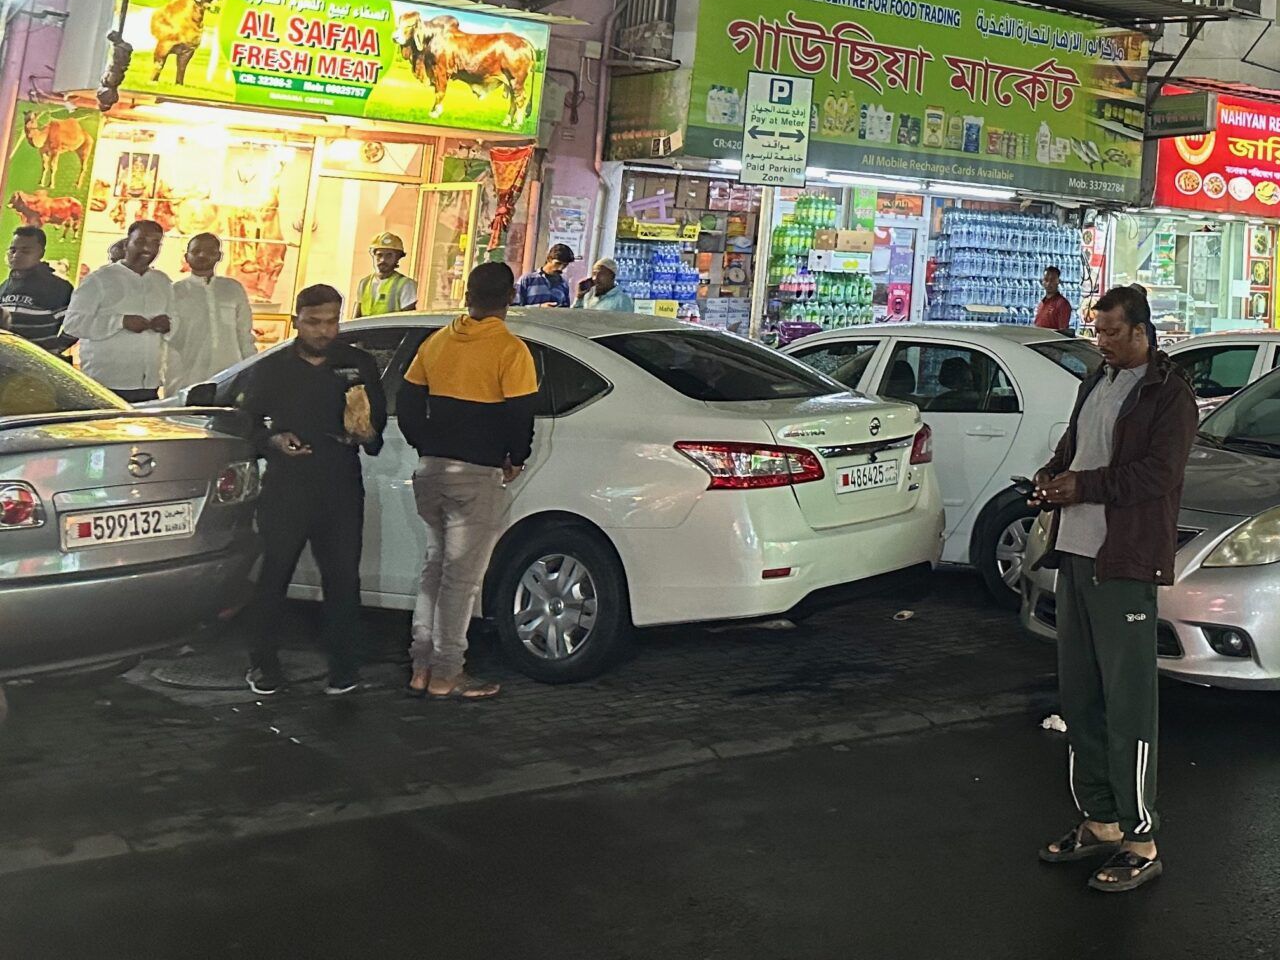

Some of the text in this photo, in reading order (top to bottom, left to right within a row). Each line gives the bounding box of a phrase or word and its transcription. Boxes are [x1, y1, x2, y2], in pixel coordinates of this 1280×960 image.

[918, 2, 961, 27] TRADING
[240, 10, 380, 56] AL SAFAA
[1016, 17, 1051, 47] لتجارة
[1083, 36, 1099, 56] نور
[1100, 37, 1124, 61] مركز
[232, 43, 383, 84] FRESH MEAT
[727, 11, 1081, 112] গাউছিয়া মার্কেট
[772, 81, 790, 103] P
[751, 114, 805, 127] Pay at Meter
[1220, 109, 1267, 131] NAHIYAN
[712, 137, 742, 150] CR:420
[762, 140, 790, 151] مواقف
[745, 152, 804, 162] خاضعة للرسوم
[746, 162, 802, 174] Paid Parking
[861, 154, 1015, 181] All Mobile Recharge Cards Available
[762, 173, 785, 182] Zone
[1068, 177, 1088, 190] Mob:
[851, 465, 884, 488] 486425
[93, 510, 162, 540] 599132
